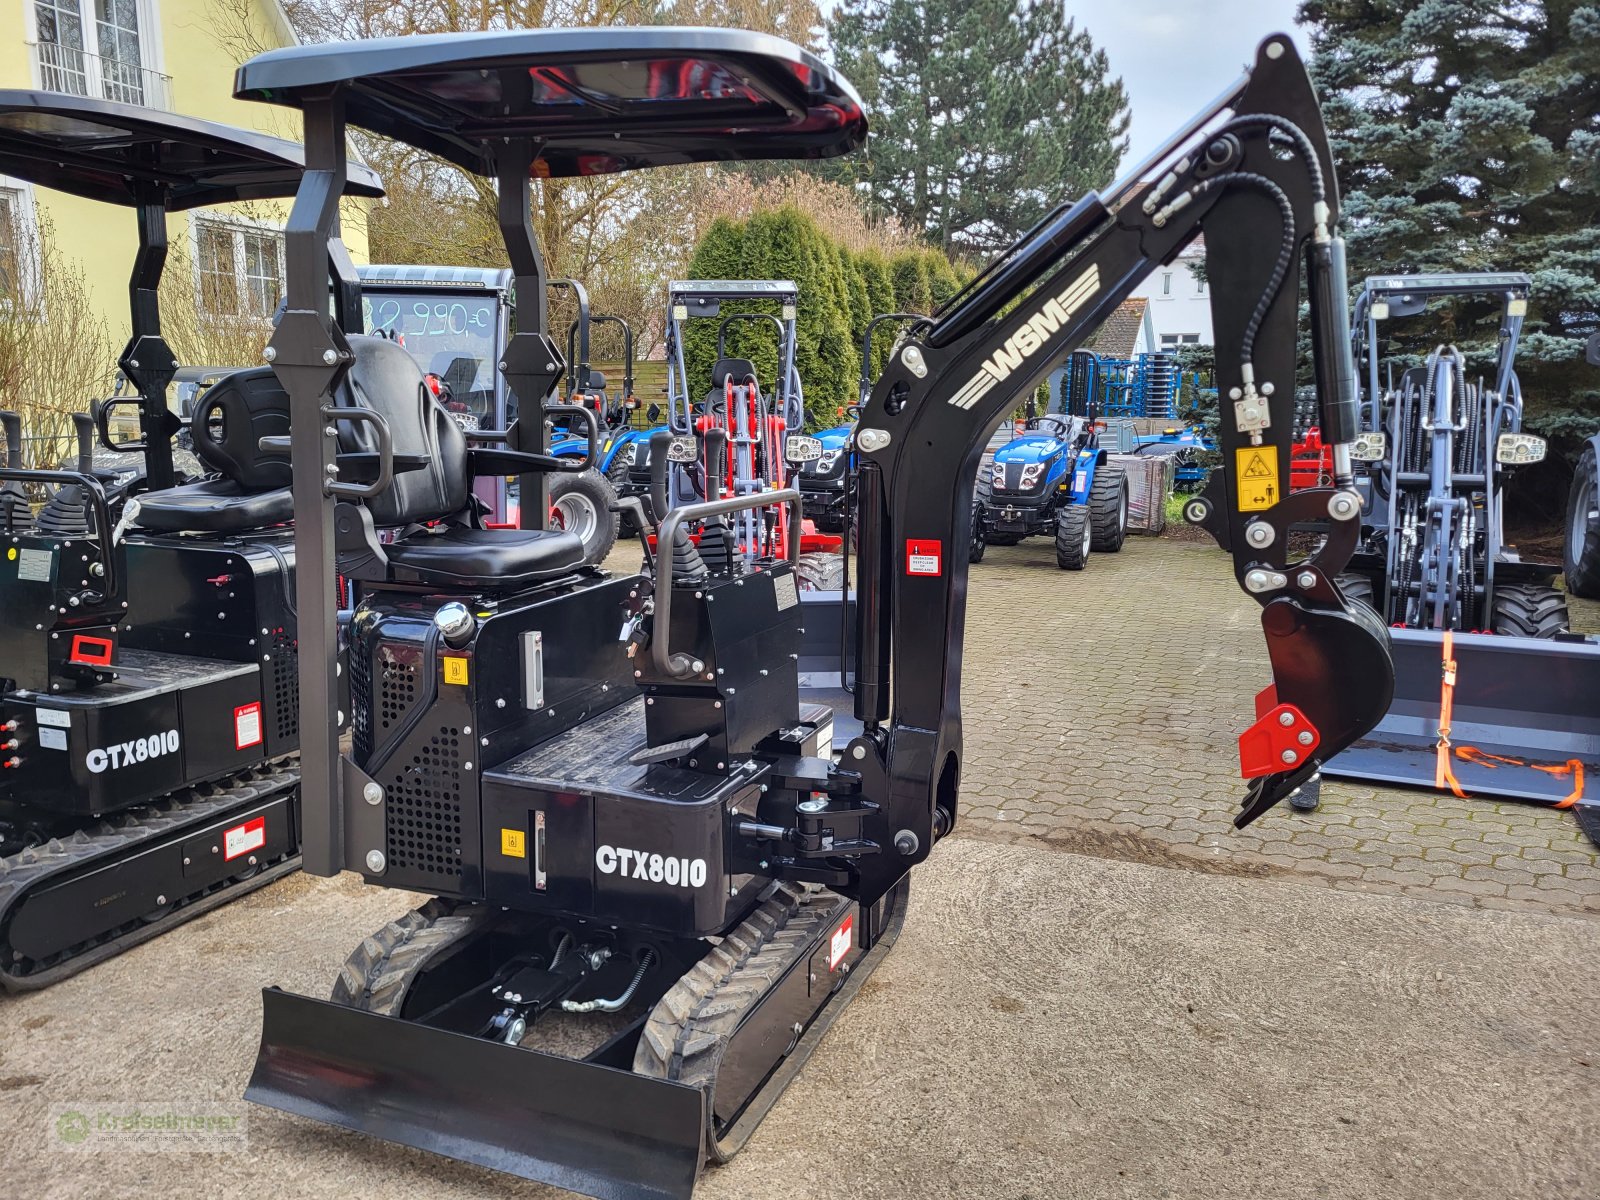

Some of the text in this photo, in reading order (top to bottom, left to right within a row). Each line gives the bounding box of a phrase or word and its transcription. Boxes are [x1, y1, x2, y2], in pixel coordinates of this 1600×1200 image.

[981, 298, 1070, 382] WSM
[86, 729, 180, 774] CTX8010
[595, 845, 707, 888] CTX8010
